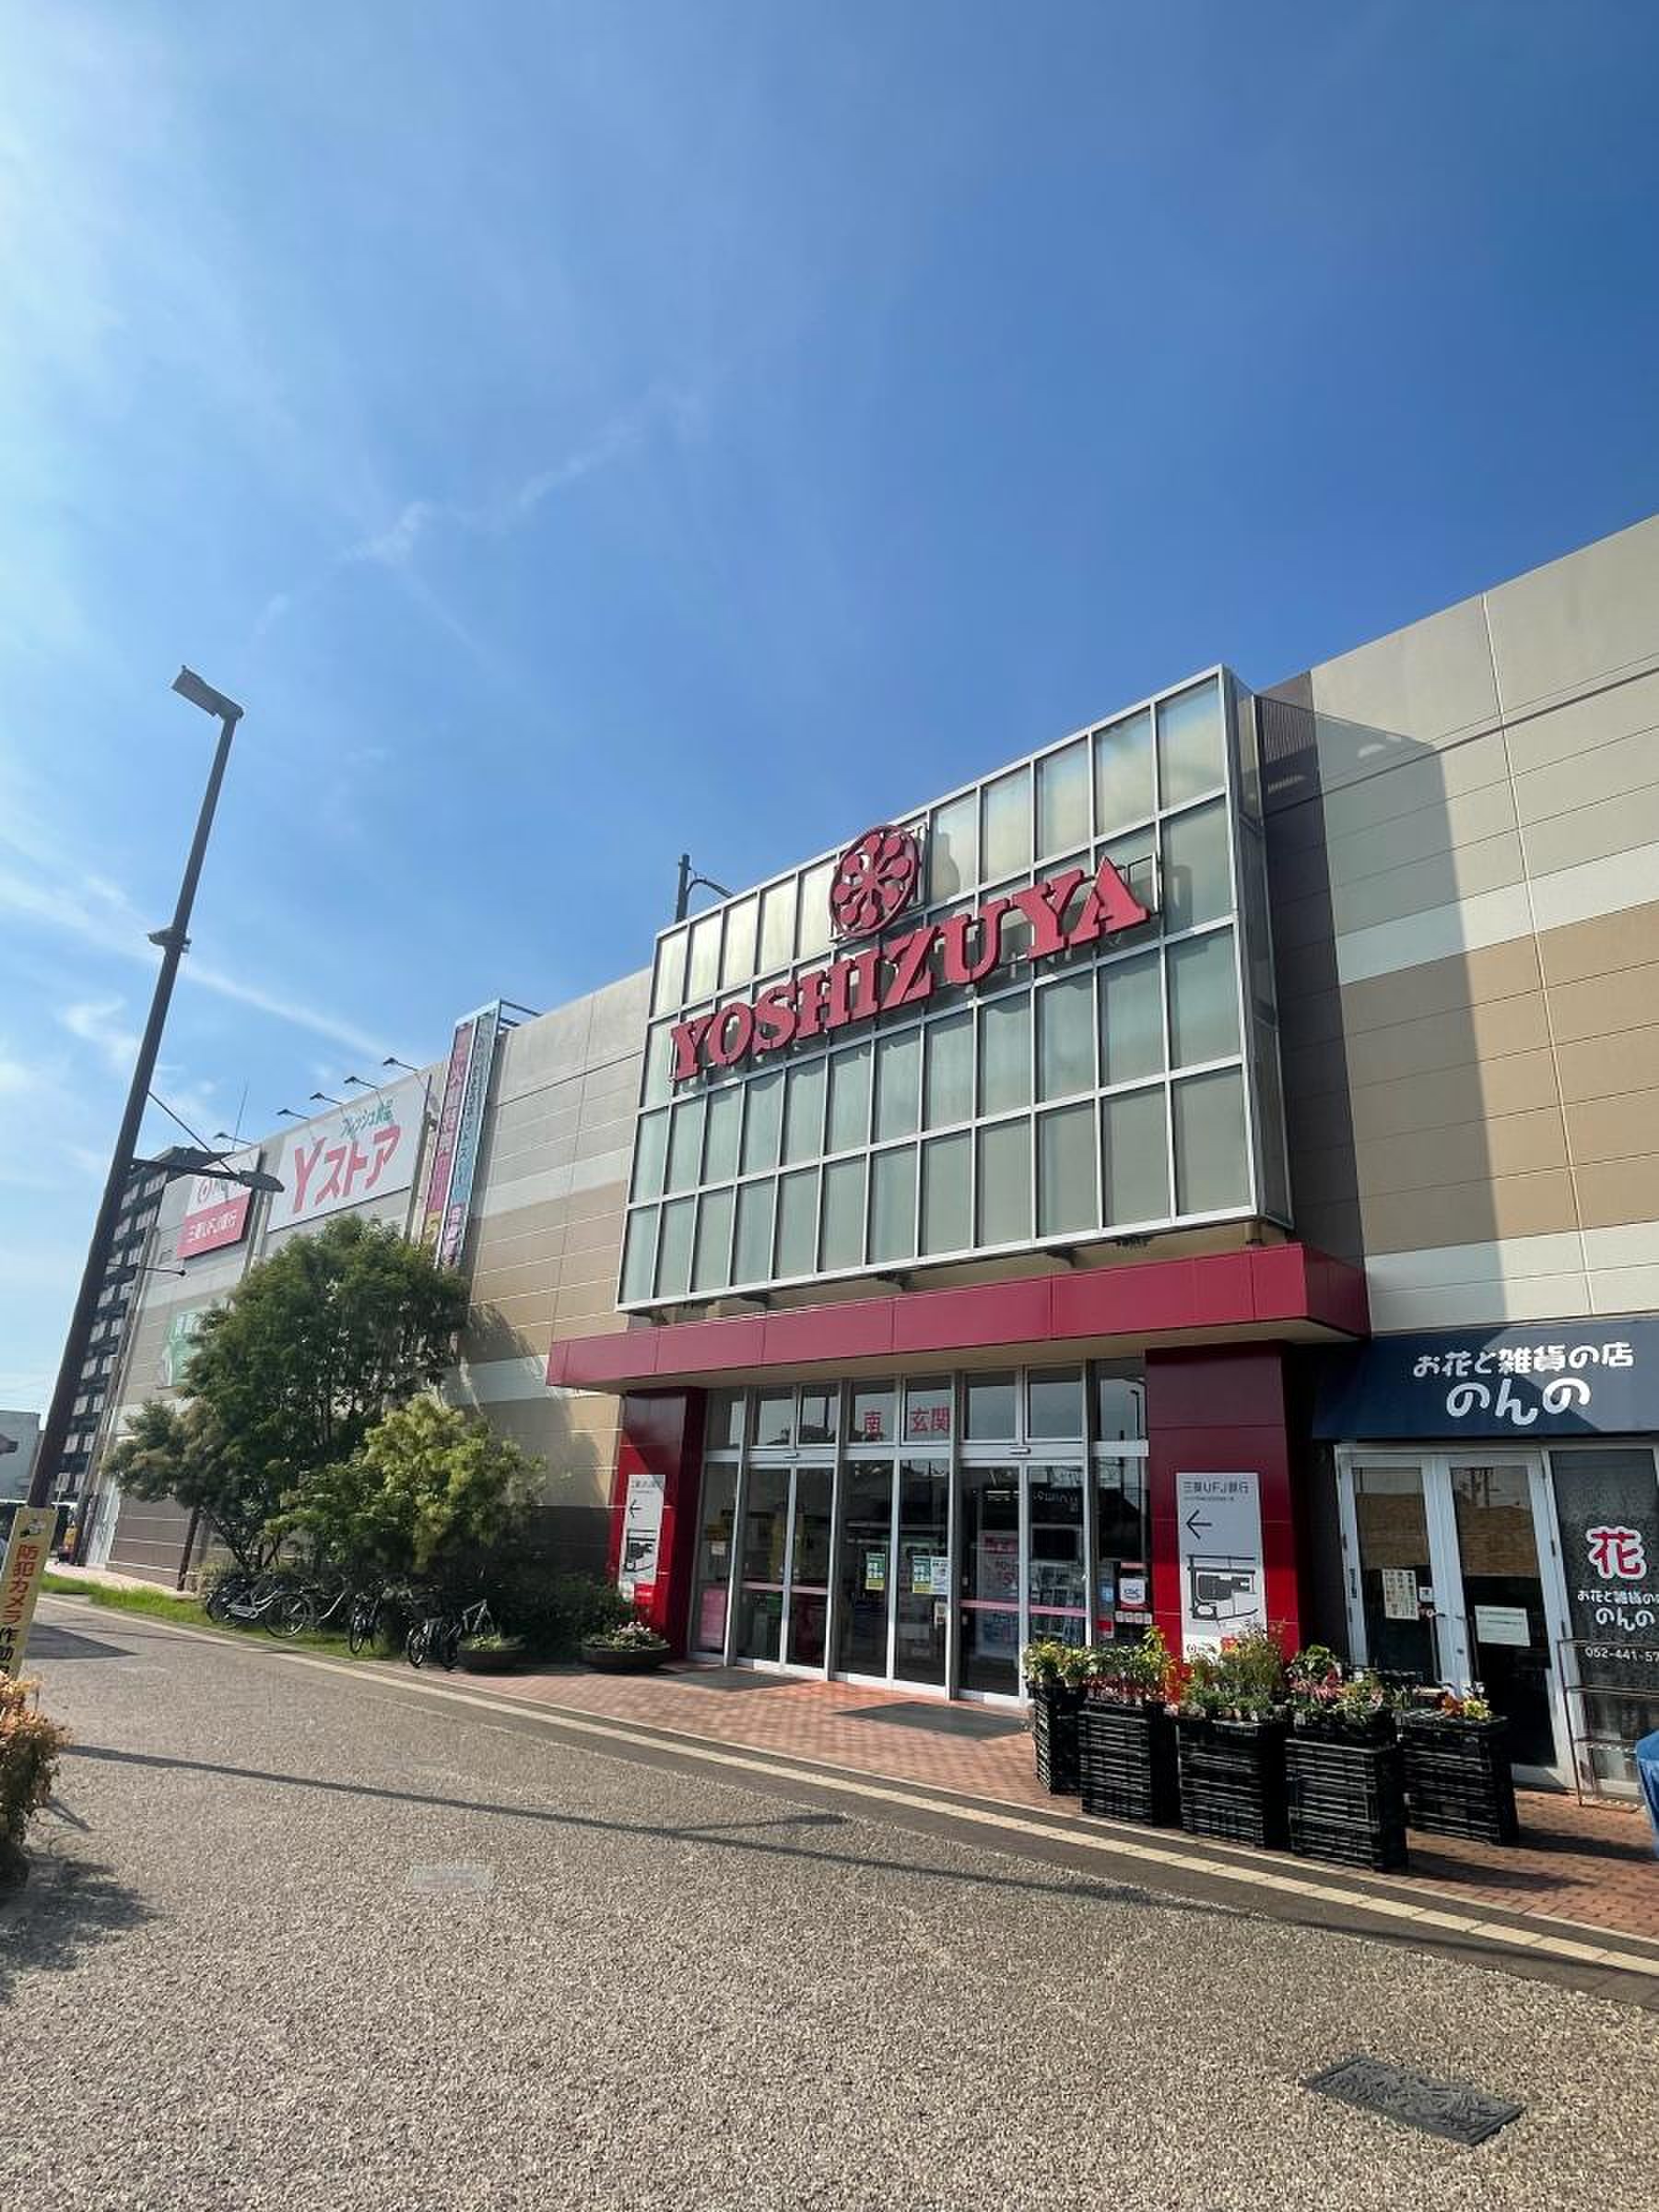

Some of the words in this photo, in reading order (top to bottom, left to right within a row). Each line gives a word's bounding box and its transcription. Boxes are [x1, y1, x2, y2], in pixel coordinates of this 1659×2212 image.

[669, 854, 1151, 1081] YOSHIZUYA
[293, 1124, 401, 1214] Yストア
[1413, 1342, 1634, 1377] お花と雑貨の店
[910, 1406, 949, 1434] 玄関
[1446, 1377, 1591, 1426] のんの
[1587, 1527, 1646, 1578] 花
[1595, 1607, 1656, 1631] のんの
